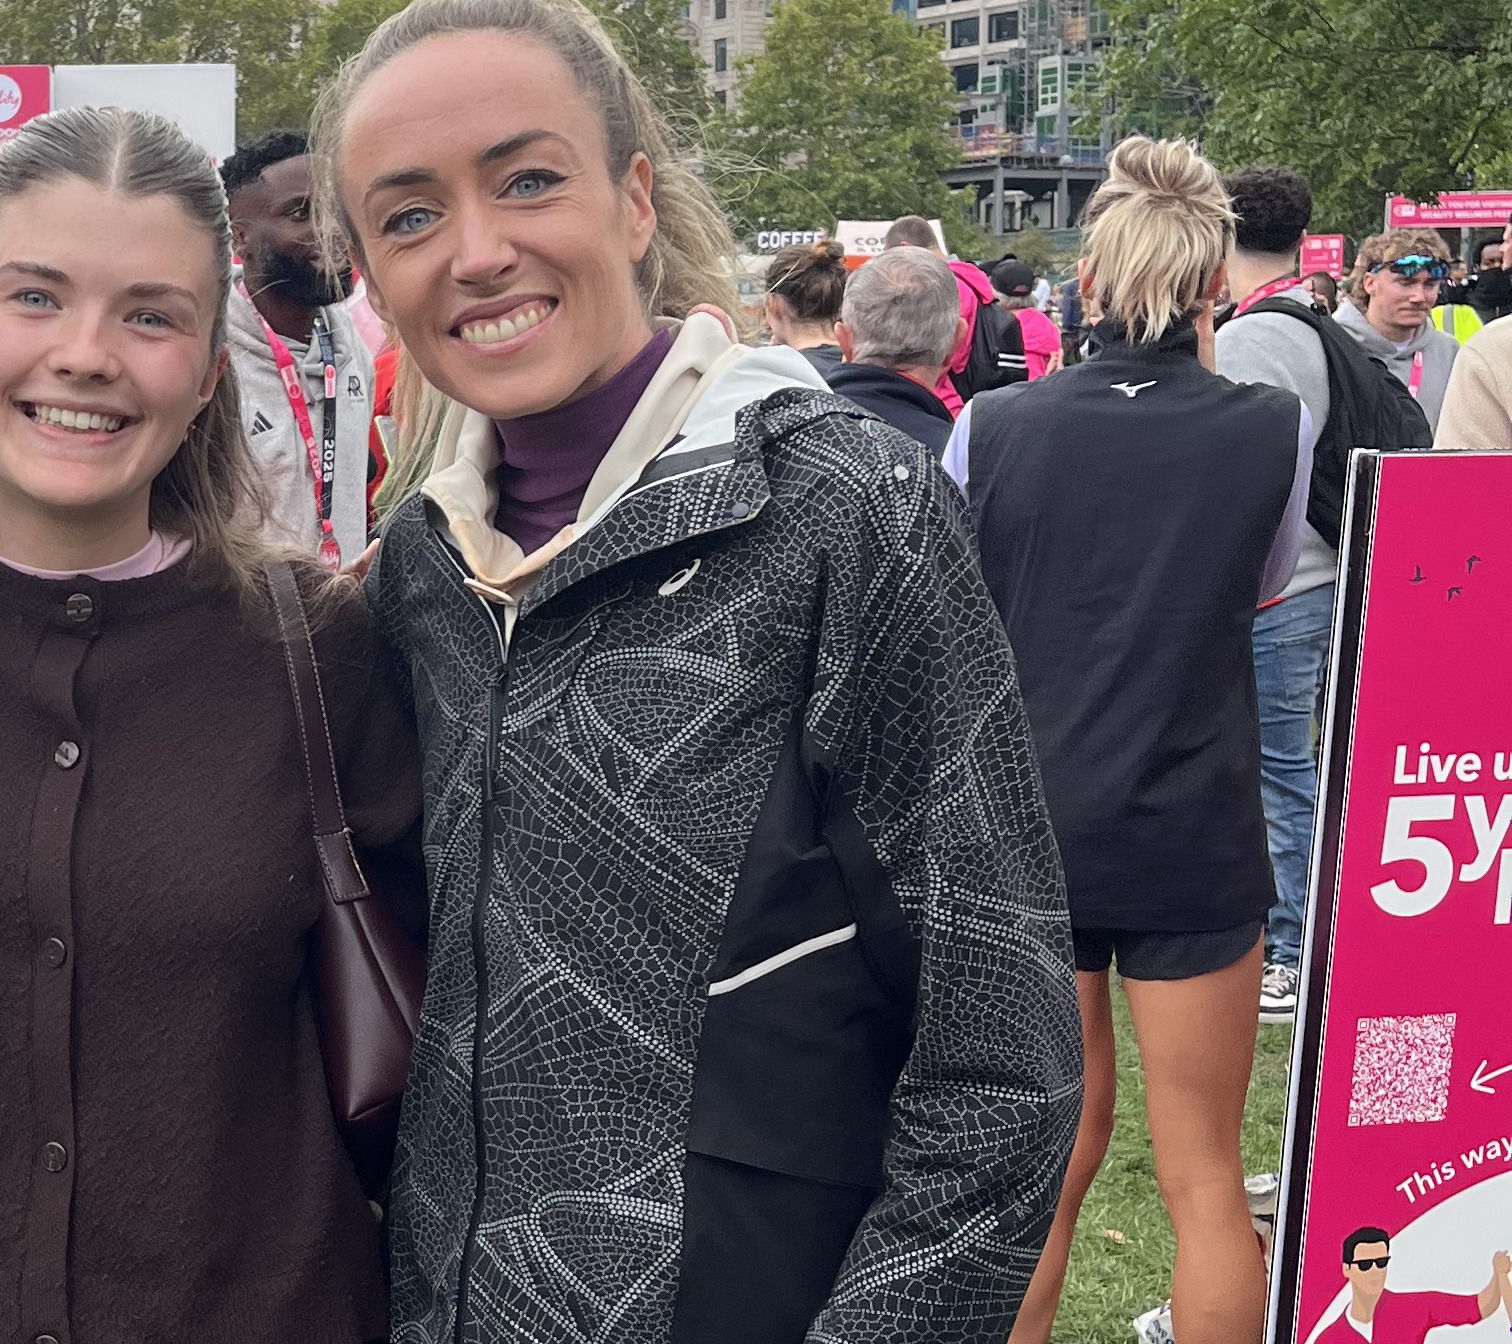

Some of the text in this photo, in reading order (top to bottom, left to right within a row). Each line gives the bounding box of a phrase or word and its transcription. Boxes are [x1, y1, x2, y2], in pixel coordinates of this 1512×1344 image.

[323, 439, 335, 483] 2025
[1394, 742, 1481, 784] Live
[1395, 1161, 1456, 1204] This
